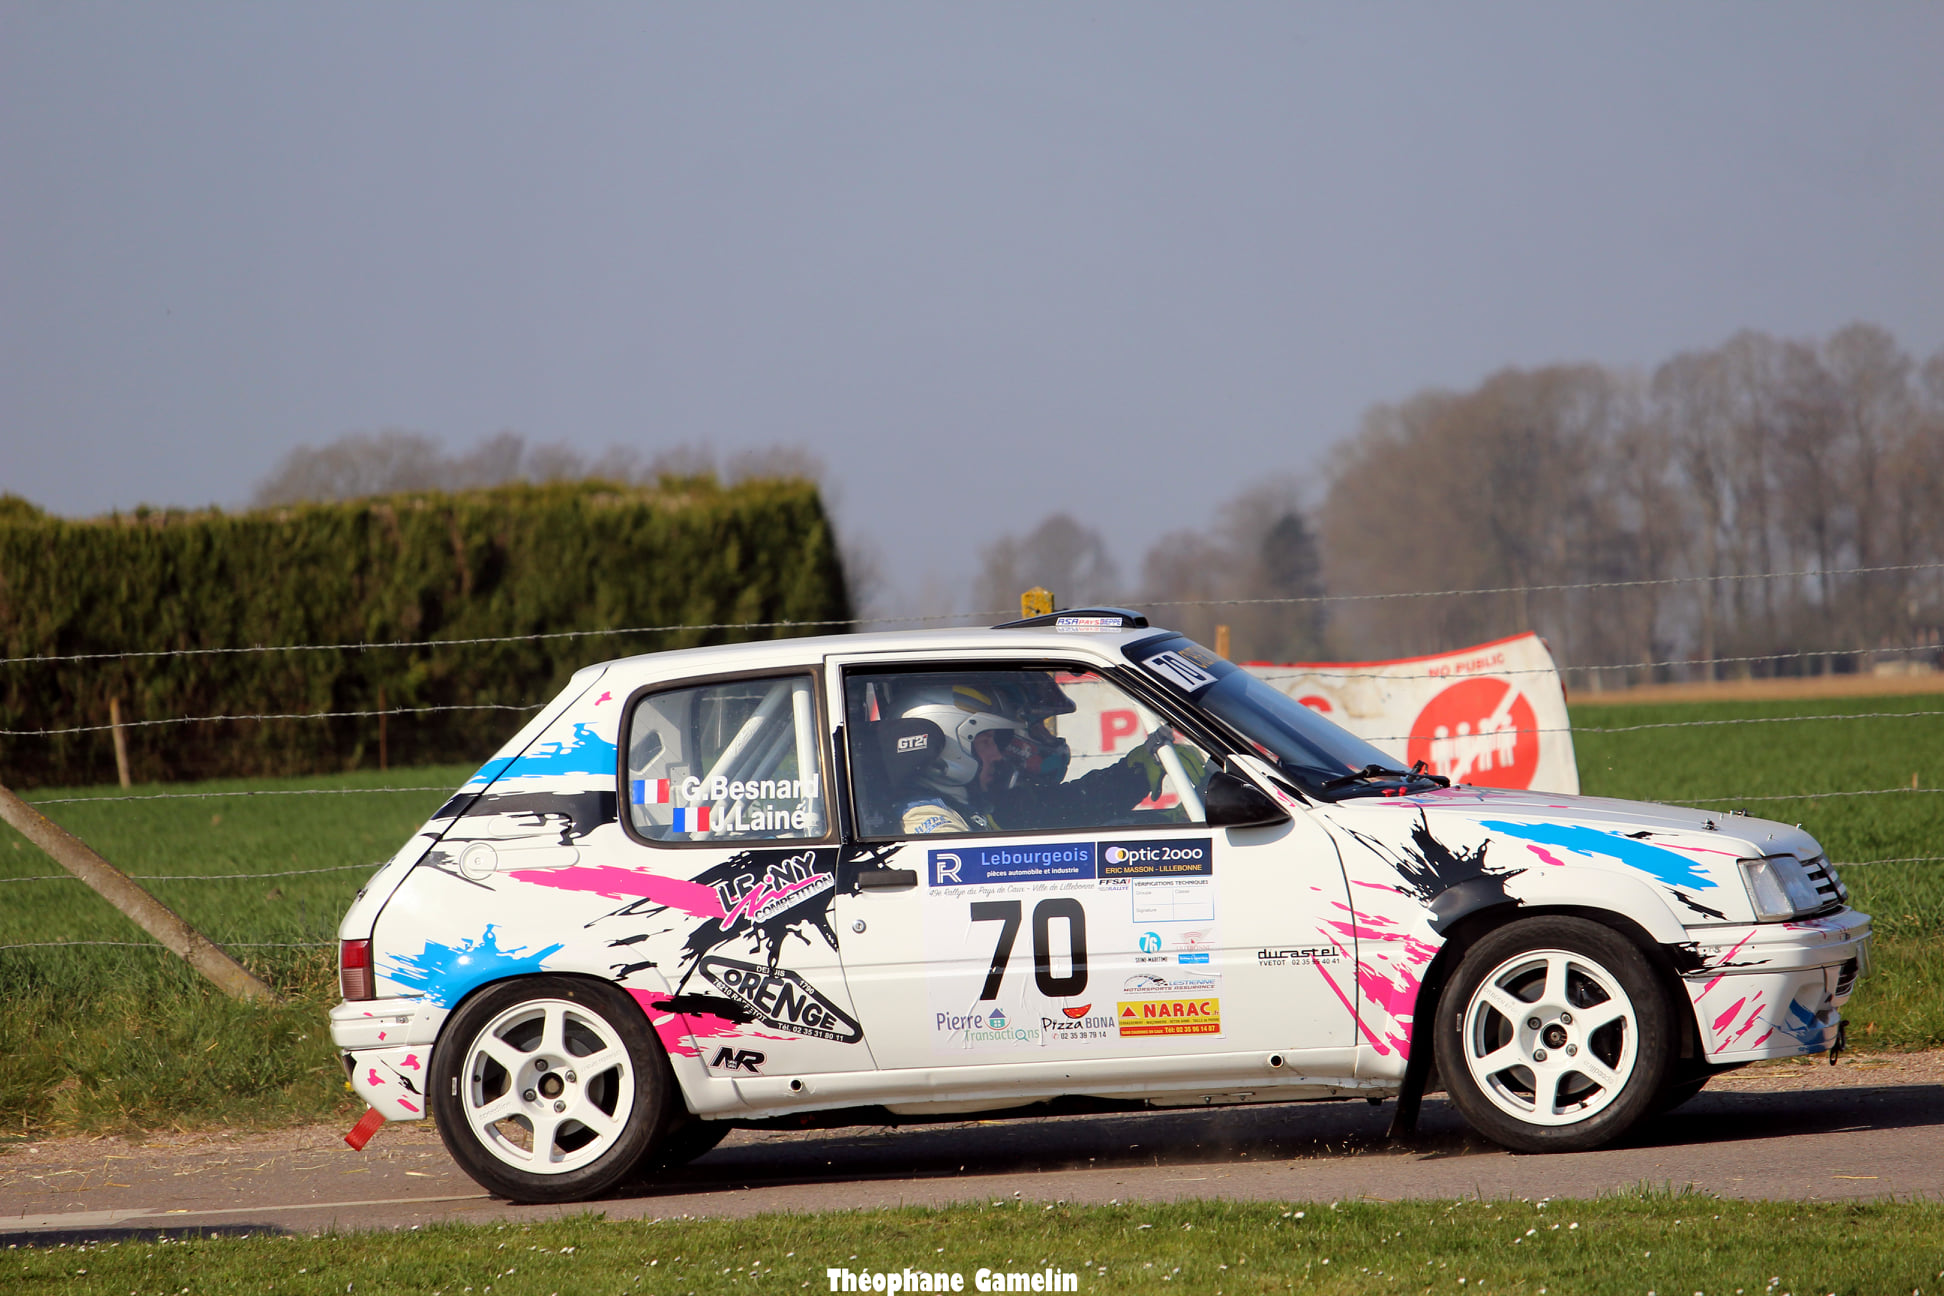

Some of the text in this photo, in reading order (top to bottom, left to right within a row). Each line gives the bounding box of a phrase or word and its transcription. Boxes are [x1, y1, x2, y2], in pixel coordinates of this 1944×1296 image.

[1152, 654, 1207, 686] 70
[1428, 652, 1505, 677] NO PUBLIC
[681, 773, 819, 801] G.Besnard
[981, 848, 1089, 867] Lebourgeois
[1115, 847, 1203, 866] Optic 2000
[1008, 868, 1043, 877] automobile
[1051, 867, 1080, 875] industrie
[1124, 865, 1154, 873] MASSON
[1159, 864, 1203, 872] LILLEBONNE
[753, 872, 835, 921] COMPETITION
[978, 886, 995, 898] Pays
[1032, 882, 1048, 892] Ville
[1060, 881, 1095, 890] Lillebonne
[970, 898, 1089, 1001] 70
[1140, 933, 1158, 952] 76
[1257, 946, 1340, 959] ducastel
[712, 978, 733, 997] 76210
[799, 980, 815, 995] 1790
[1143, 1001, 1211, 1018] NARAC
[936, 1011, 983, 1031] Pierre
[1042, 1016, 1115, 1032] Pizza BONA
[792, 1026, 802, 1034] 02
[803, 1028, 813, 1036] 35
[814, 1030, 823, 1038] 31
[824, 1032, 834, 1040] 80
[836, 1034, 844, 1042] 11
